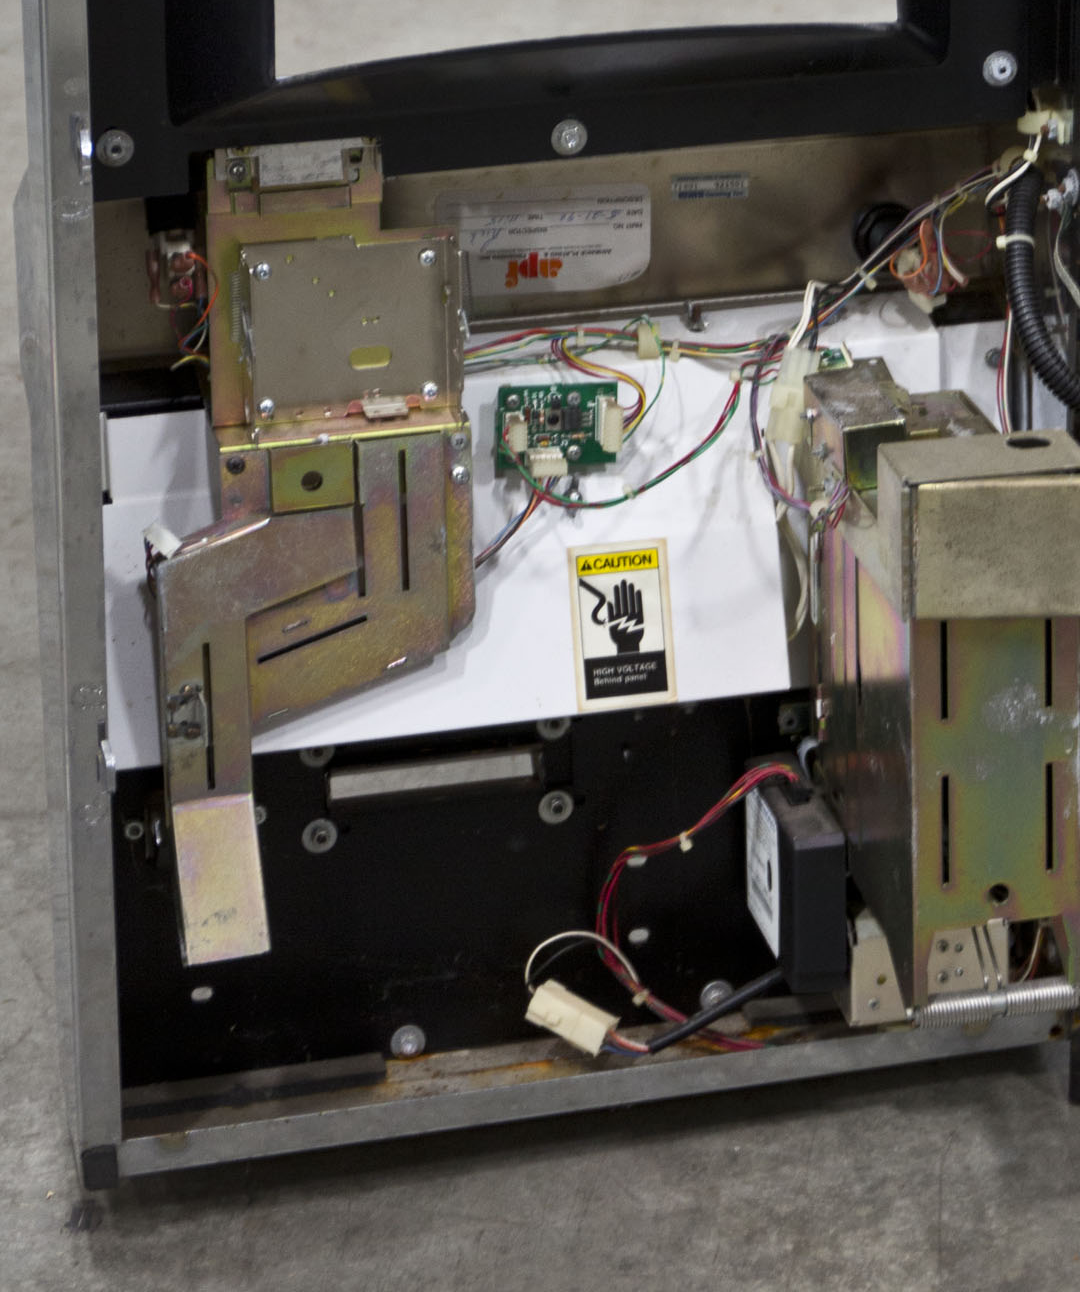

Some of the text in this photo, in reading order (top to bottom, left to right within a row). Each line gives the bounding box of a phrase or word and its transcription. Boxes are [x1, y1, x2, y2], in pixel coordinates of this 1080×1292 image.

[505, 252, 563, 289] apf
[593, 554, 652, 570] CAUTION
[593, 661, 657, 677] HIGH VOLTAGE
[594, 673, 647, 686] Behind panel
